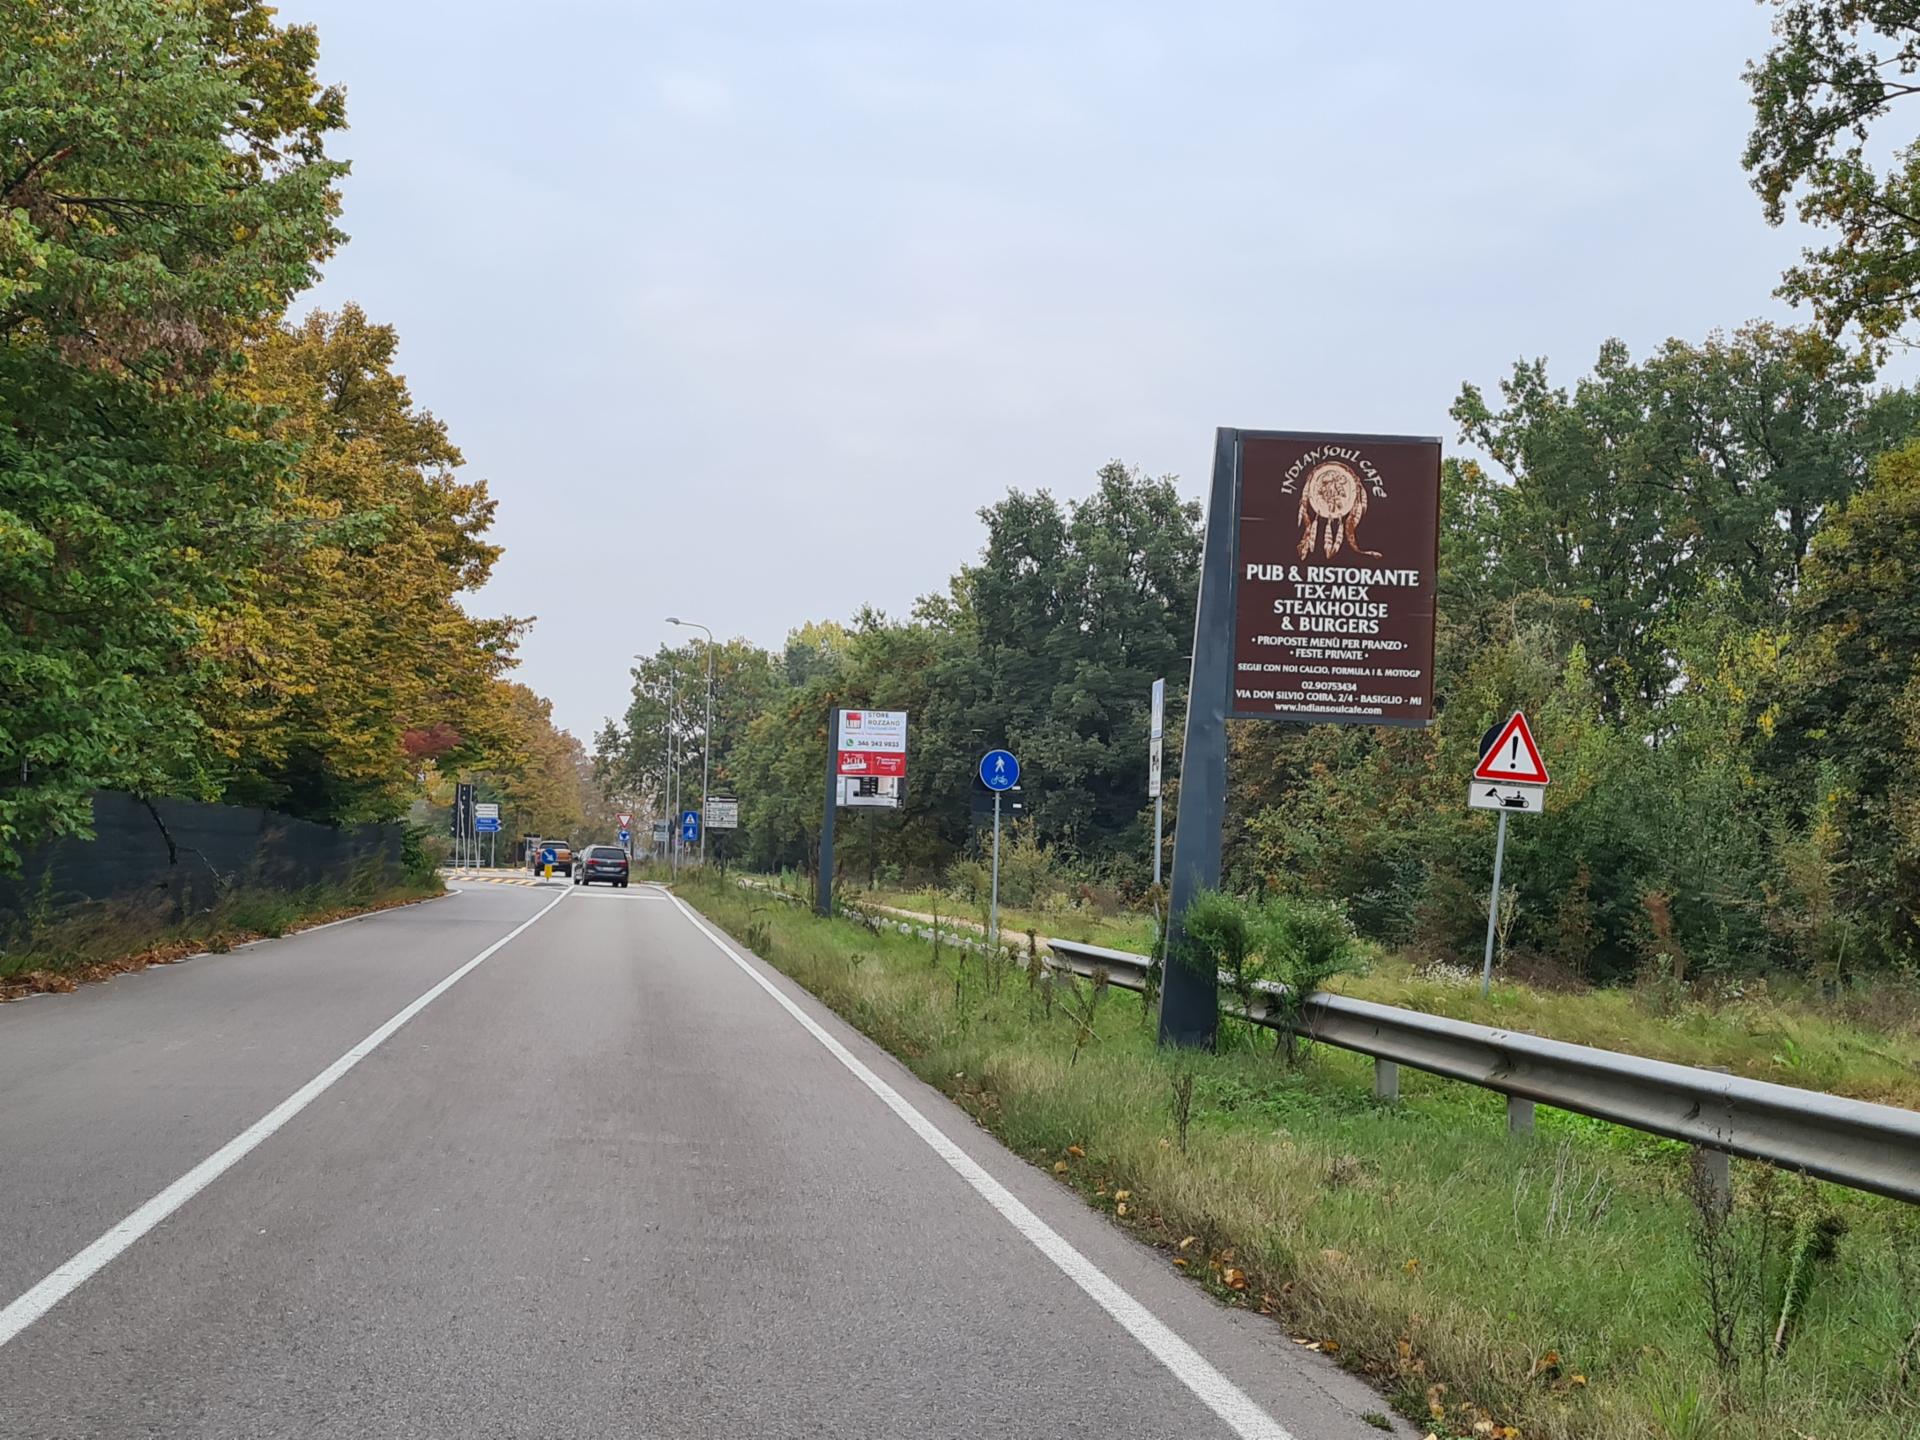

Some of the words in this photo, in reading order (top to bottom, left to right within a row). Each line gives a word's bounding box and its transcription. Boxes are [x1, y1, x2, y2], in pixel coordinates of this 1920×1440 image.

[1281, 447, 1321, 495] INDIAN
[1320, 444, 1361, 463] SOUL
[1246, 563, 1284, 581] PUB
[1288, 564, 1303, 582] &
[1306, 566, 1419, 587] RISTORANTE
[1294, 583, 1369, 601] TEX-MEX
[1273, 599, 1389, 619] STEAKHOUSE
[1280, 615, 1294, 632] &
[1299, 616, 1380, 634] BURGERS
[1257, 635, 1309, 647] PROPOSTE
[1341, 639, 1361, 650] PER
[1361, 639, 1403, 651] PRANZO
[1295, 648, 1324, 660] FESTE
[1324, 649, 1364, 661] PRIVATE
[1237, 663, 1262, 672] SEGUI
[1263, 664, 1281, 673] CON
[1282, 665, 1298, 673] NOI
[1331, 667, 1371, 677] FORMULA
[1376, 668, 1383, 677] &
[1384, 668, 1421, 679] MOTOGP
[1301, 681, 1358, 692] 02.90753434
[1235, 689, 1252, 699] VIA
[1252, 690, 1275, 699] DON
[1276, 691, 1305, 701] SILVIO
[1338, 694, 1354, 703] 2/4
[1360, 694, 1403, 705] BASIGLIO
[1409, 696, 1422, 706] MI
[1274, 703, 1382, 715] www.indiansoulcafe.com
